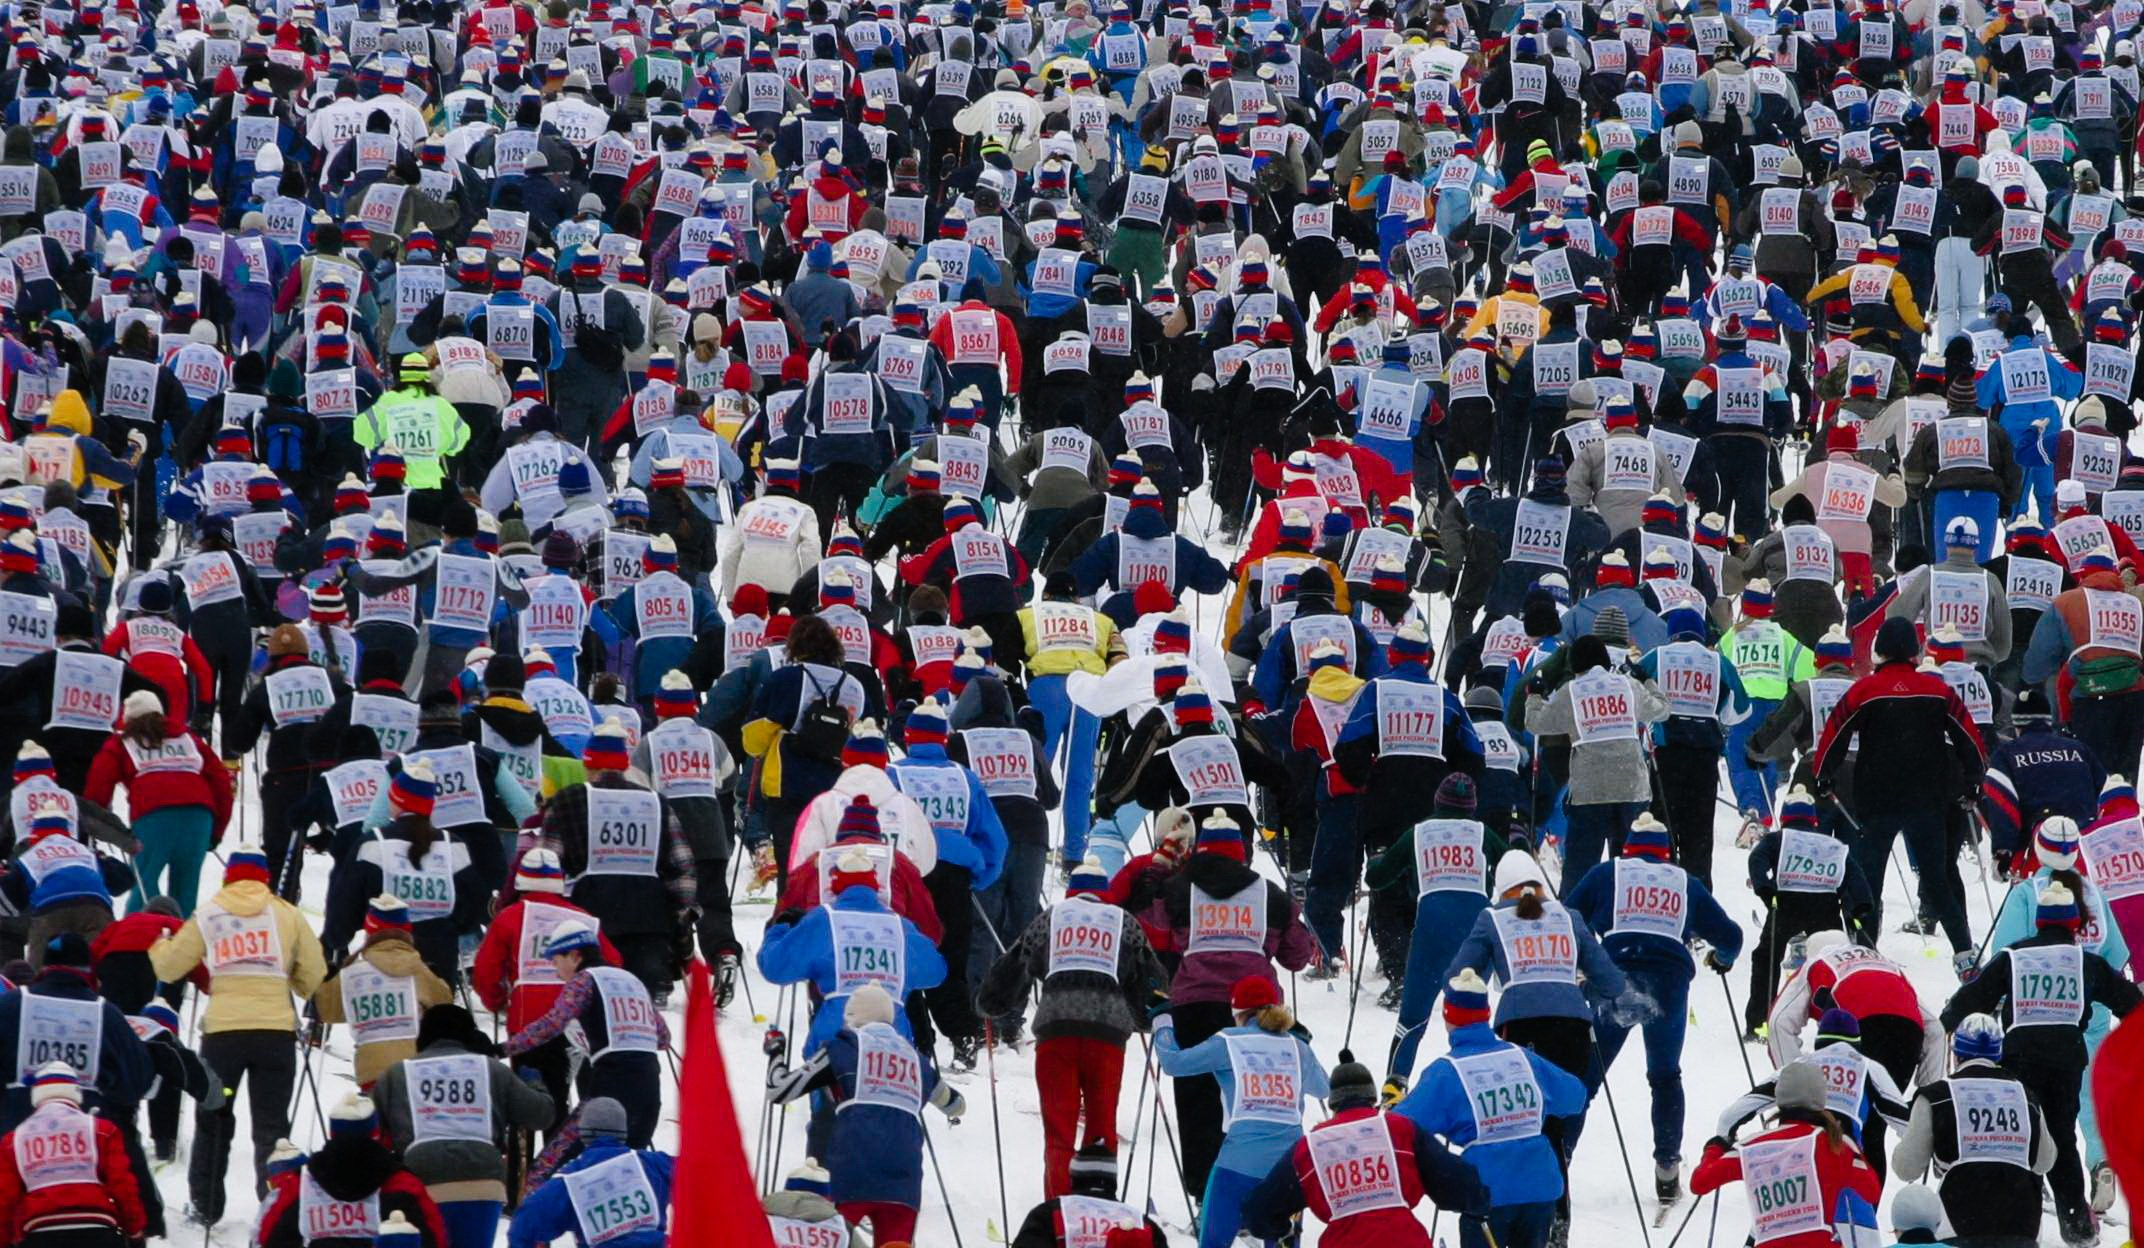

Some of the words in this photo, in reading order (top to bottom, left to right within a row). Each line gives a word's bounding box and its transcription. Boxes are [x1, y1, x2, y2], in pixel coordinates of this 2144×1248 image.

[1865, 33, 1887, 44] 9438
[1112, 52, 1135, 64] 4889
[940, 71, 964, 83] 6339
[1668, 62, 1692, 74] 6636
[754, 84, 778, 96] 6582
[1520, 77, 1541, 88] 7122
[1420, 89, 1443, 100] 9656
[2083, 94, 2103, 105] 7911
[998, 111, 1022, 123] 6266
[1080, 111, 1101, 123] 6269
[1174, 113, 1199, 126] 4955
[1624, 106, 1647, 117] 5686
[1256, 131, 1282, 142] 8713
[1945, 123, 1967, 136] 7440
[1368, 136, 1393, 147] 5057
[601, 147, 626, 160] 8705
[88, 163, 113, 176] 8691
[1193, 168, 1217, 181] 9180
[1995, 161, 2021, 173] 7580
[1, 182, 29, 197] 5516
[1674, 178, 1701, 191] 4890
[664, 188, 693, 201] 8688
[1132, 190, 1159, 207] 6358
[1768, 208, 1792, 220] 8140
[1904, 203, 1929, 217] 8149
[268, 216, 293, 228] 4624
[687, 229, 714, 242] 9605
[2009, 228, 2035, 240] 7898
[850, 246, 878, 260] 8695
[1038, 267, 1065, 281] 7841
[2093, 274, 2123, 284] 15640
[495, 327, 527, 343] 6870
[1094, 327, 1124, 343] 7848
[1501, 322, 1534, 337] 15695
[962, 334, 990, 349] 8567
[1668, 333, 1699, 346] 15696
[449, 348, 480, 358] 8182
[755, 344, 782, 359] 8184
[1051, 346, 1082, 357] 8698
[184, 363, 217, 382] 11580
[884, 359, 913, 374] 8769
[1256, 364, 1288, 376] 11791
[1540, 368, 1570, 382] 7205
[2011, 370, 2046, 388] 12173
[110, 384, 149, 403] 10262
[315, 390, 350, 408] 8072
[1726, 392, 1759, 408] 5443
[638, 398, 666, 416] 8138
[828, 400, 867, 416] 10578
[1128, 418, 1164, 430] 11787
[1370, 408, 1402, 426] 4666
[394, 430, 431, 448] 17261
[1051, 436, 1084, 451] 9009
[1944, 439, 1980, 455] 14273
[518, 459, 559, 480] 17262
[946, 461, 979, 480] 8843
[1615, 456, 1648, 472] 7468
[2083, 457, 2113, 474] 9233
[1828, 490, 1864, 510] 16336
[750, 516, 789, 534] 14145
[1518, 526, 1561, 546] 12253
[2065, 532, 2104, 552] 15637
[967, 541, 1000, 557] 8154
[1795, 547, 1828, 563] 8132
[1128, 564, 1167, 584] 11180
[2012, 577, 2053, 596] 12418
[441, 587, 485, 611] 11712
[645, 598, 685, 616] 8054
[531, 605, 573, 624] 11140
[1939, 603, 1979, 624] 11135
[2097, 610, 2136, 632] 11355
[7, 615, 47, 638] 9443
[1044, 617, 1088, 634] 11284
[1736, 644, 1780, 663] 17674
[1666, 670, 1712, 693] 11784
[63, 688, 112, 712] 10943
[278, 689, 325, 708] 17710
[1581, 696, 1627, 717] 11886
[1387, 712, 1434, 735] 11177
[659, 751, 711, 774] 10544
[976, 755, 1028, 777] 10799
[2015, 749, 2083, 768] RUSSIA
[1188, 762, 1236, 787] 11501
[915, 797, 966, 820] 7343
[600, 822, 648, 846] 6301
[1423, 846, 1475, 868] 11983
[1784, 854, 1838, 877] 17930
[2096, 851, 2144, 879] 11570
[391, 874, 447, 900] 15882
[1625, 886, 1681, 914] 10520
[1198, 904, 1252, 926] 13914
[214, 931, 269, 962] 14037
[1056, 927, 1112, 950] 10990
[1513, 934, 1571, 959] 18170
[843, 946, 896, 975] 17341
[2022, 974, 2078, 1000] 17923
[352, 992, 406, 1022] 15881
[29, 1040, 88, 1069] 10385
[867, 1051, 918, 1083] 11574
[421, 1079, 476, 1104] 9588
[1242, 1073, 1294, 1100] 18355
[1478, 1083, 1537, 1119] 17342
[1968, 1108, 2020, 1132] 9248
[24, 1133, 86, 1163] 10786
[1325, 1156, 1390, 1190] 10856
[1754, 1176, 1807, 1214] 18007
[309, 1203, 366, 1231] 11504
[586, 1191, 651, 1232] 17553
[785, 1226, 840, 1248] 11557
